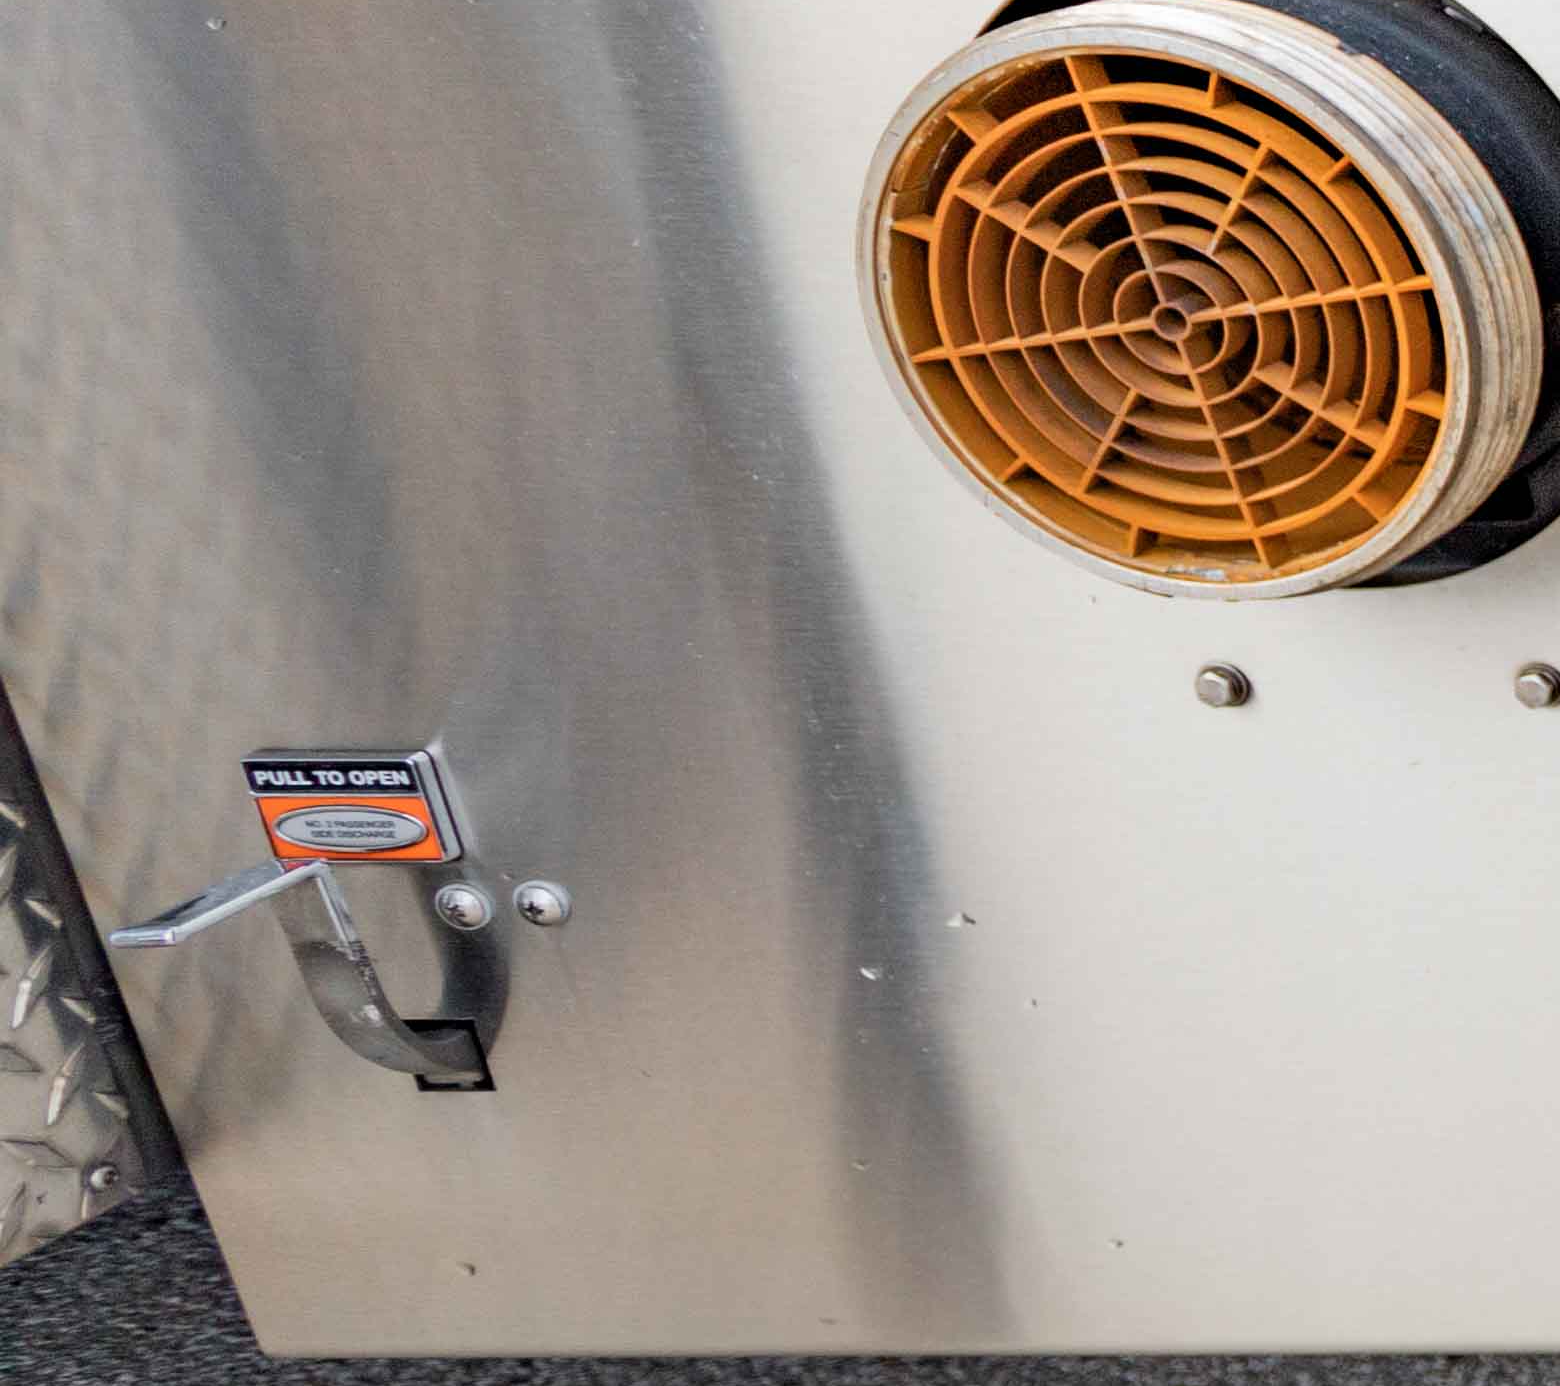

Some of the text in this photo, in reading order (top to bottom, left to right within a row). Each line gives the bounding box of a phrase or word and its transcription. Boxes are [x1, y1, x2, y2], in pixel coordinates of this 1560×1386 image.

[253, 770, 411, 786] PULL TO OPEN
[333, 820, 396, 829] PASSENGER
[310, 830, 397, 839] SIDE DISCHARGE
